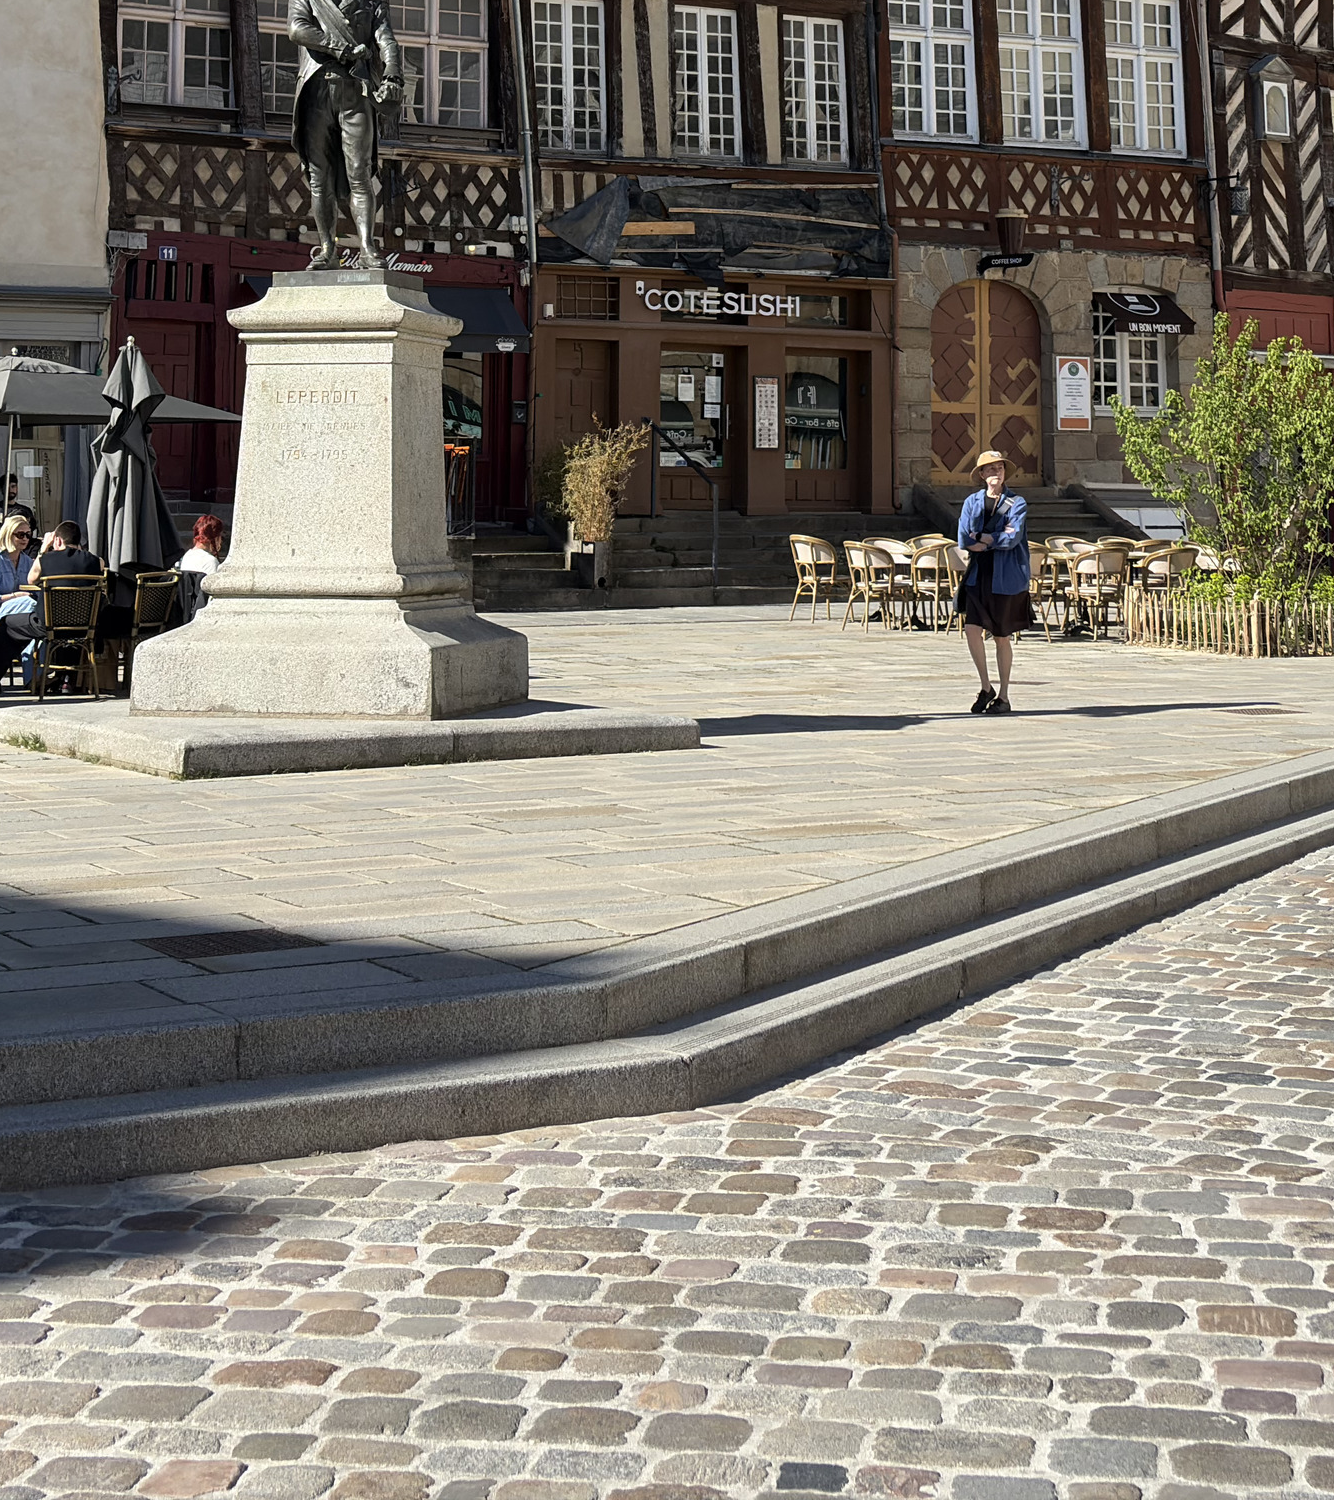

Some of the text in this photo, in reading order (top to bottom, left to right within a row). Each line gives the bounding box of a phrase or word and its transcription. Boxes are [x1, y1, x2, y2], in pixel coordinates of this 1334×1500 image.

[163, 248, 173, 259] 11
[1128, 322, 1181, 334] UN BON MOMENT
[276, 390, 359, 404] LEPERDIT
